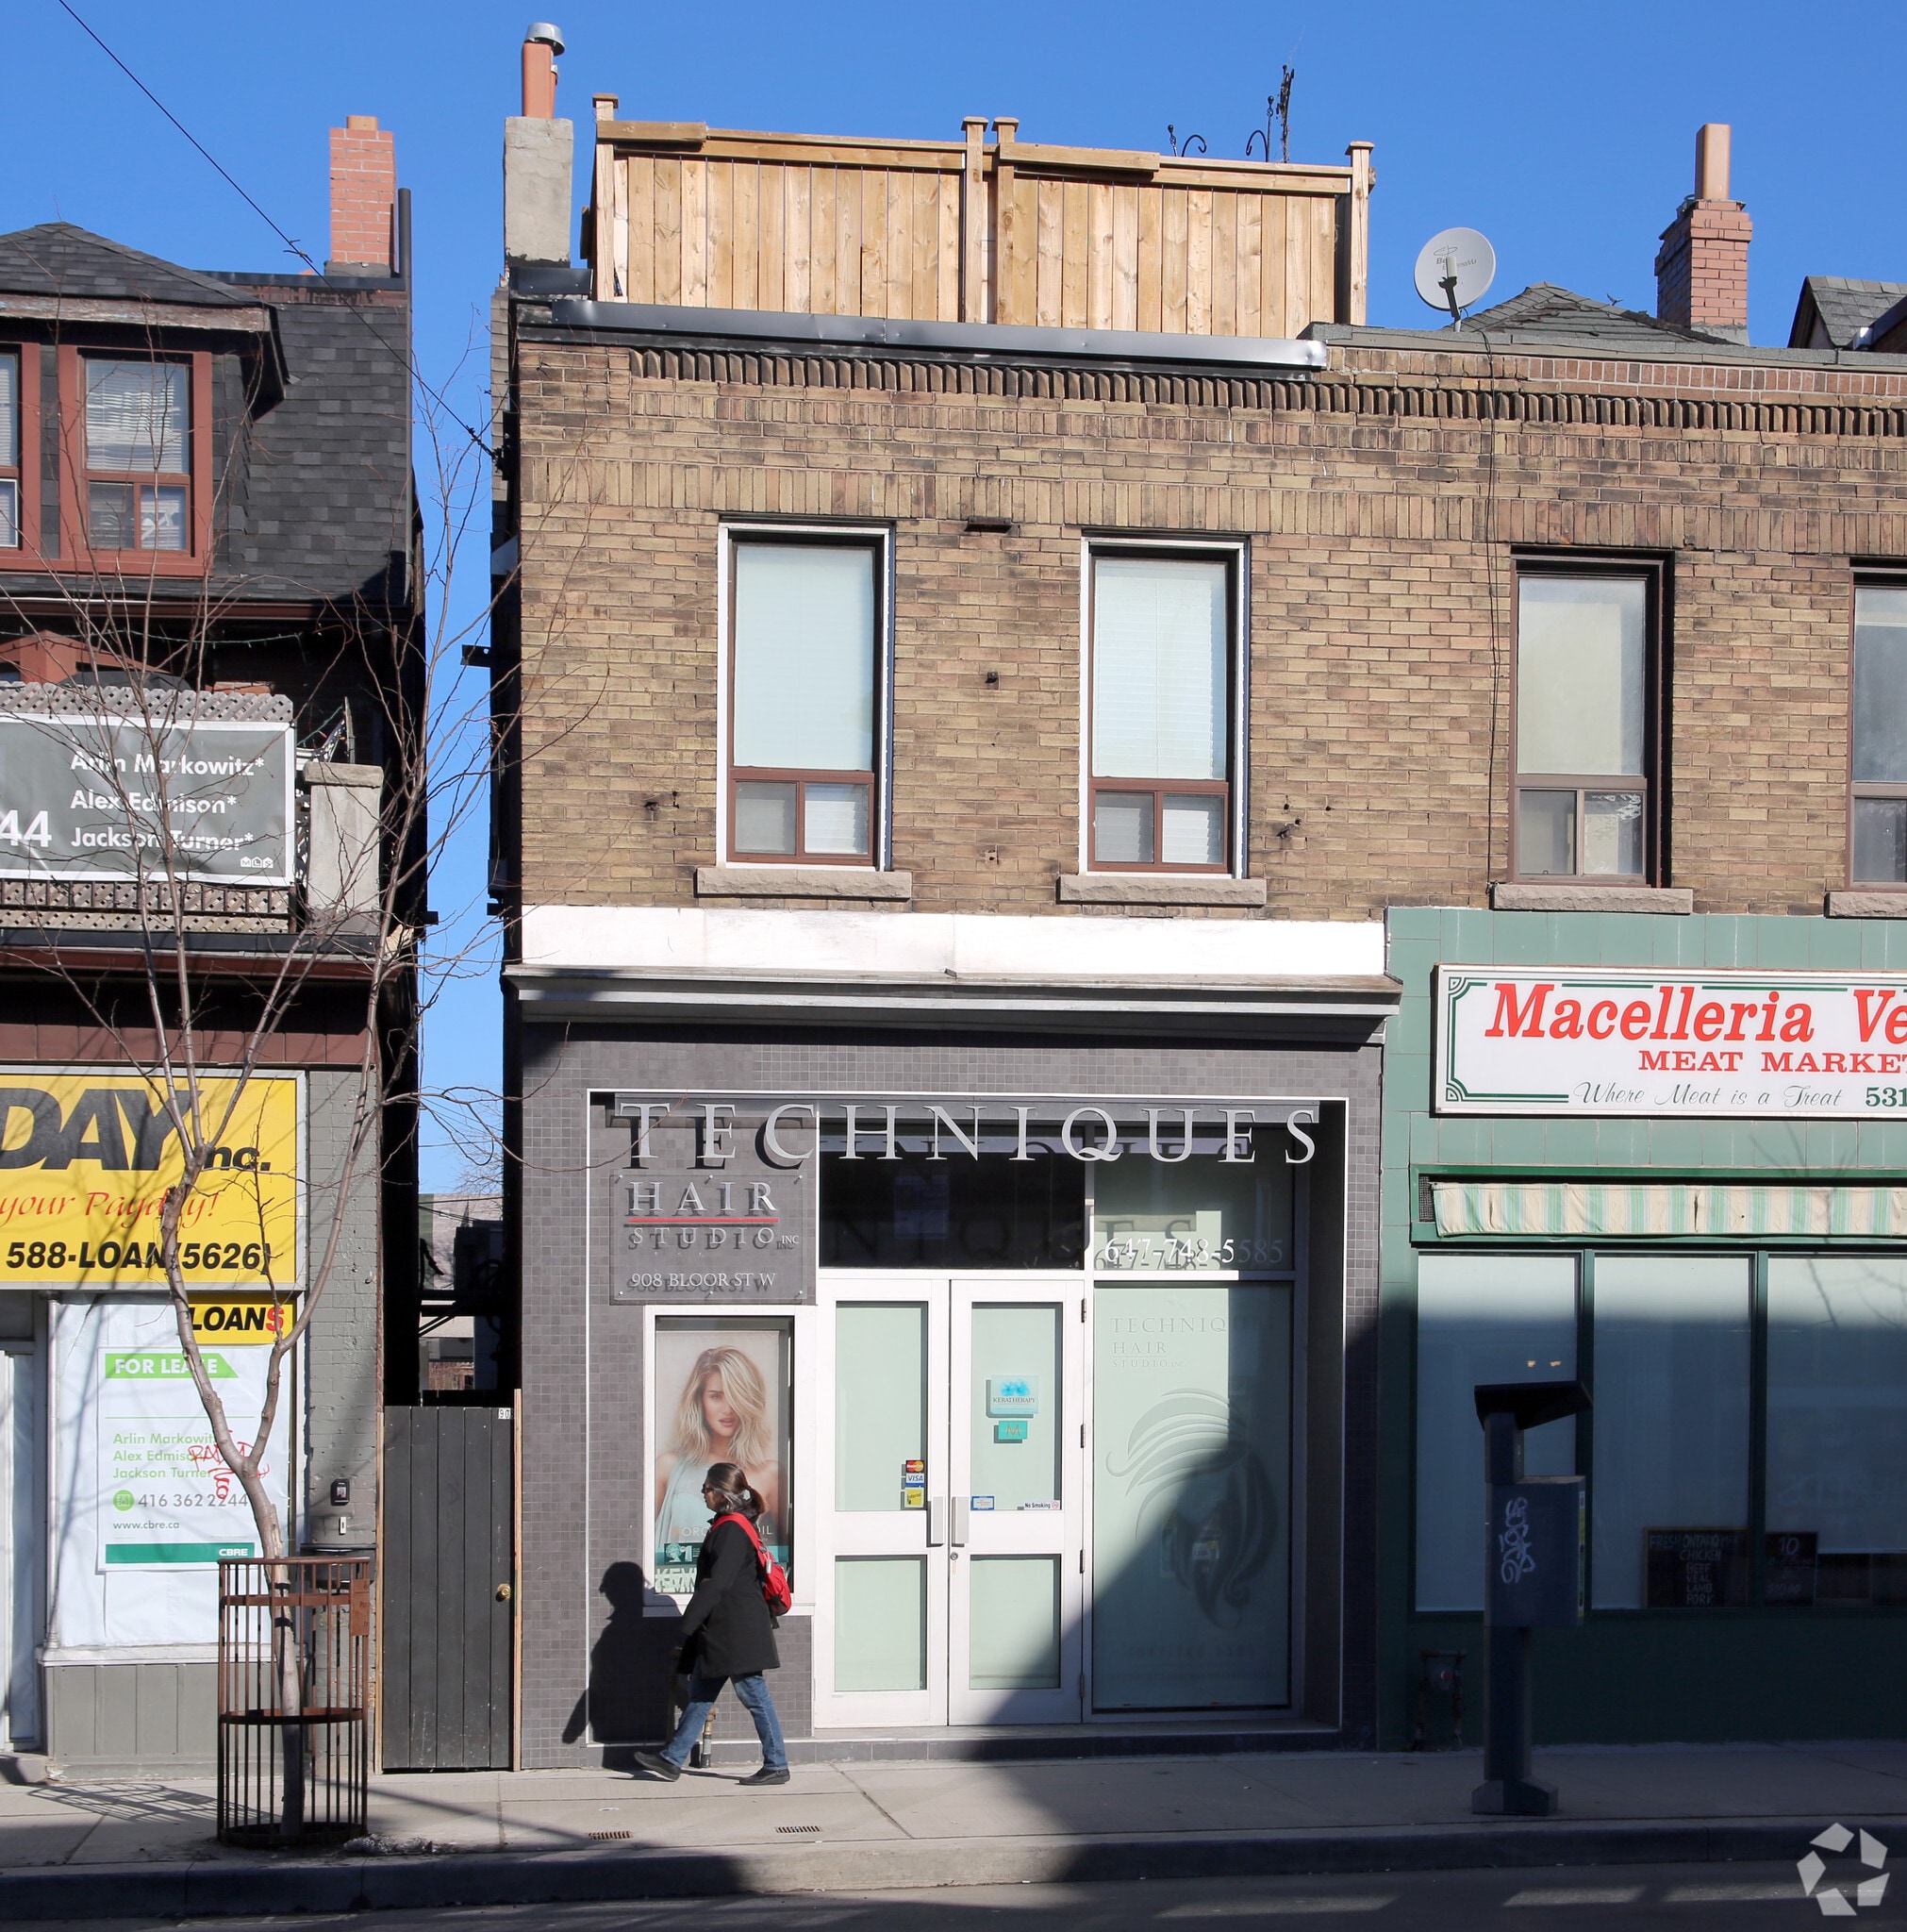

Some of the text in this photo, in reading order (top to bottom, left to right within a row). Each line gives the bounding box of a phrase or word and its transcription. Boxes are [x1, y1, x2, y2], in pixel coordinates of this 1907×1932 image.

[70, 751, 126, 773] Arlin
[70, 789, 121, 809] Alex
[0, 809, 52, 847] 44
[71, 826, 162, 849] Jackson
[1484, 983, 1907, 1044] Macelleria Ve
[1638, 1050, 1743, 1073] MEAT
[1573, 1081, 1645, 1105] Where
[1654, 1084, 1721, 1106] Meat
[1732, 1088, 1747, 1106] is
[1757, 1091, 1770, 1106] a
[1784, 1085, 1842, 1108] Treat
[0, 1088, 204, 1171] DAY
[620, 1102, 1316, 1164] TECHNIQUES
[629, 1181, 777, 1211] HAIR
[0, 1186, 220, 1228] your Paydy!
[633, 1227, 799, 1244] STUDIO INC
[631, 1274, 775, 1287] 908 BLOOR ST W
[1113, 1341, 1168, 1355] HAIR
[115, 1358, 218, 1374] FOR LEAE
[1113, 1359, 1168, 1368] STUDIO
[113, 1433, 217, 1444] Arlin Markowit
[113, 1450, 141, 1461] Alex
[112, 1467, 211, 1478] Jackson Turner
[138, 1493, 248, 1507] 416 362 2244
[113, 1520, 180, 1529] www.cbre.ca
[219, 1548, 248, 1557] CBRE
[1779, 1536, 1799, 1556] 10
[1680, 1548, 1721, 1562] CHICKEN
[1686, 1562, 1711, 1574] BEEF
[1686, 1574, 1711, 1583] VEAL
[1686, 1583, 1712, 1593] LAMB
[1686, 1593, 1714, 1606] PORK
